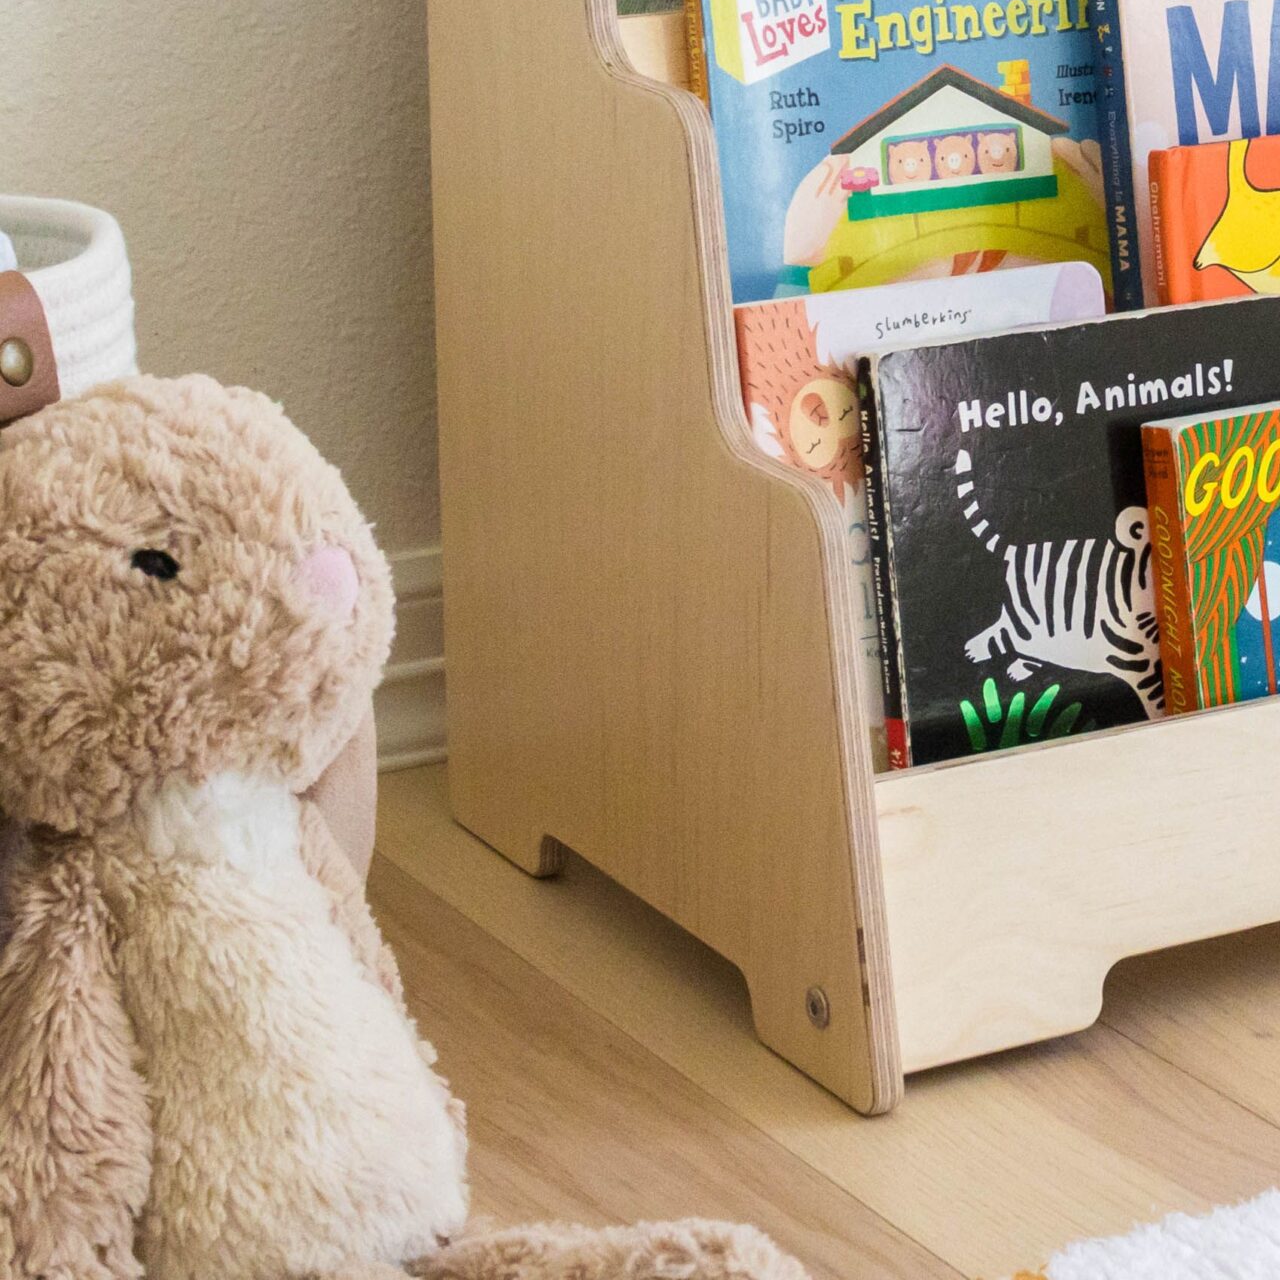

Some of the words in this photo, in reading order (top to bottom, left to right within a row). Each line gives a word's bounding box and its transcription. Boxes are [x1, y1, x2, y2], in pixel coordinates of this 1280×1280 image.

[741, 4, 827, 66] Loves
[769, 88, 820, 110] Ruth
[1058, 89, 1097, 106] Iren
[772, 119, 825, 144] Spiro
[1115, 205, 1130, 272] MAMA
[875, 310, 968, 339] slumberkins
[958, 389, 1064, 433] Hello,
[1075, 359, 1233, 414] Animals!
[1155, 507, 1182, 657] GOODNIGHT
